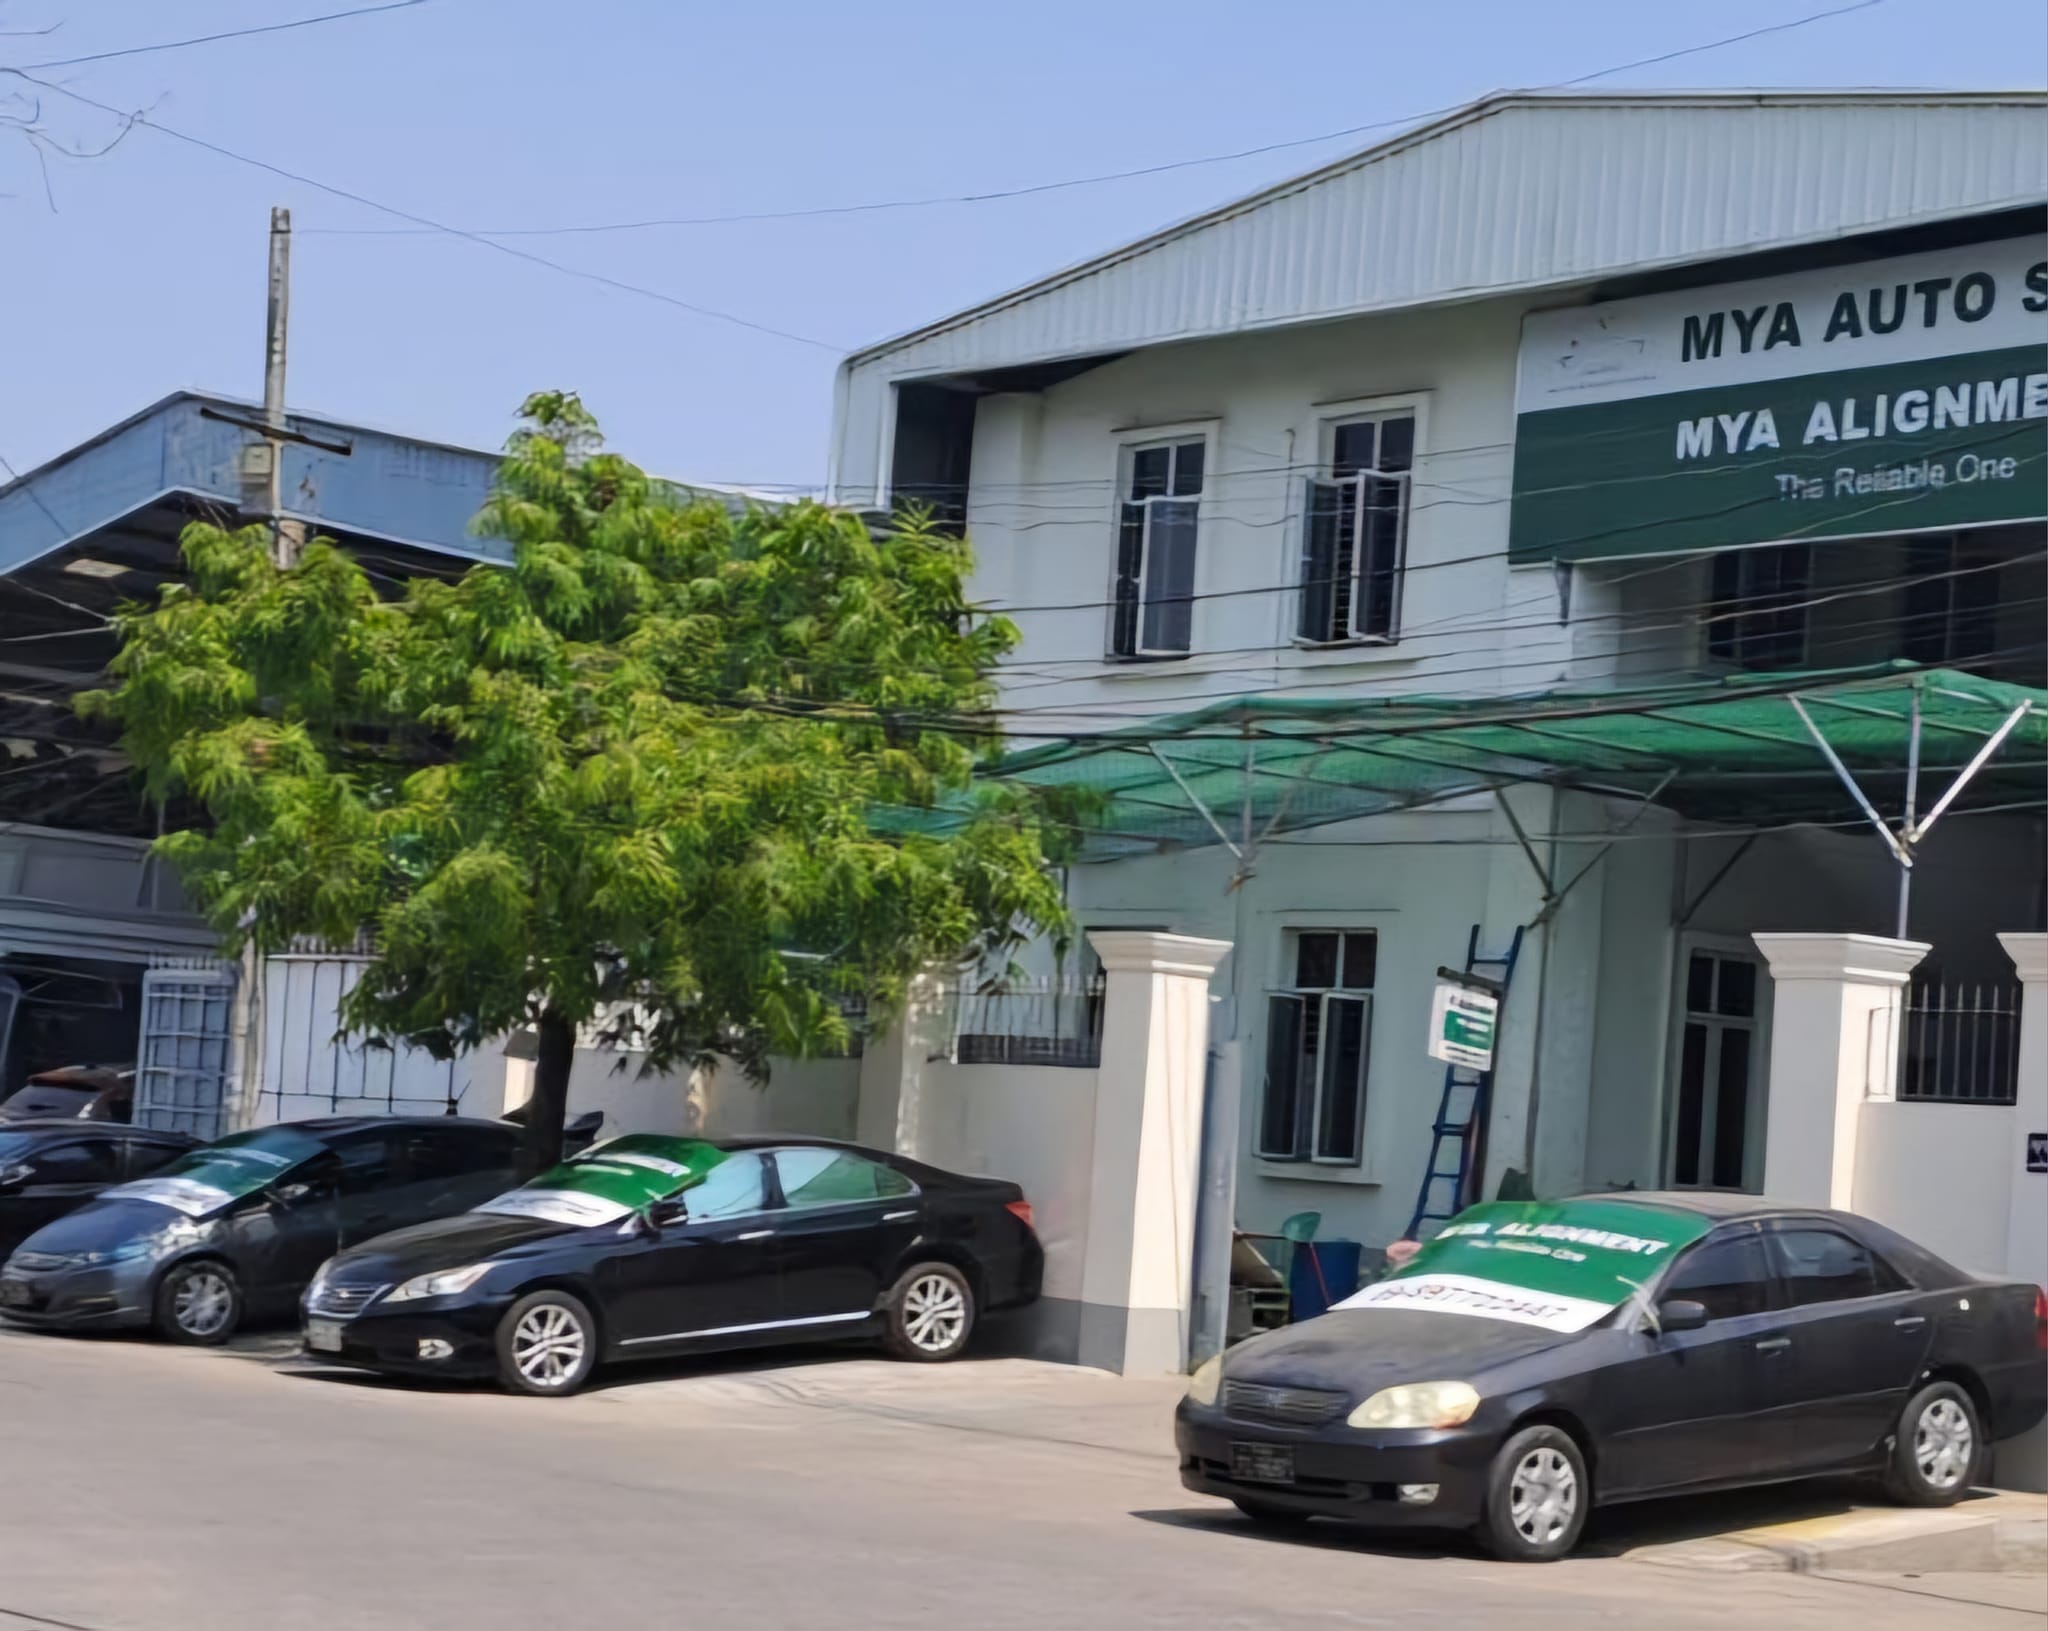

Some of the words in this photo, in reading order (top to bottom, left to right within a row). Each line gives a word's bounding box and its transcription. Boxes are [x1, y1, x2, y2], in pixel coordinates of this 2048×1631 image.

[1681, 302, 1801, 362] MYA
[1823, 271, 1997, 343] AUTO
[1676, 407, 1780, 460] MYA
[1802, 372, 2048, 446] ALIGNME
[1774, 473, 1824, 501] The
[1834, 459, 1946, 497] Reliable
[1955, 453, 2017, 483] One
